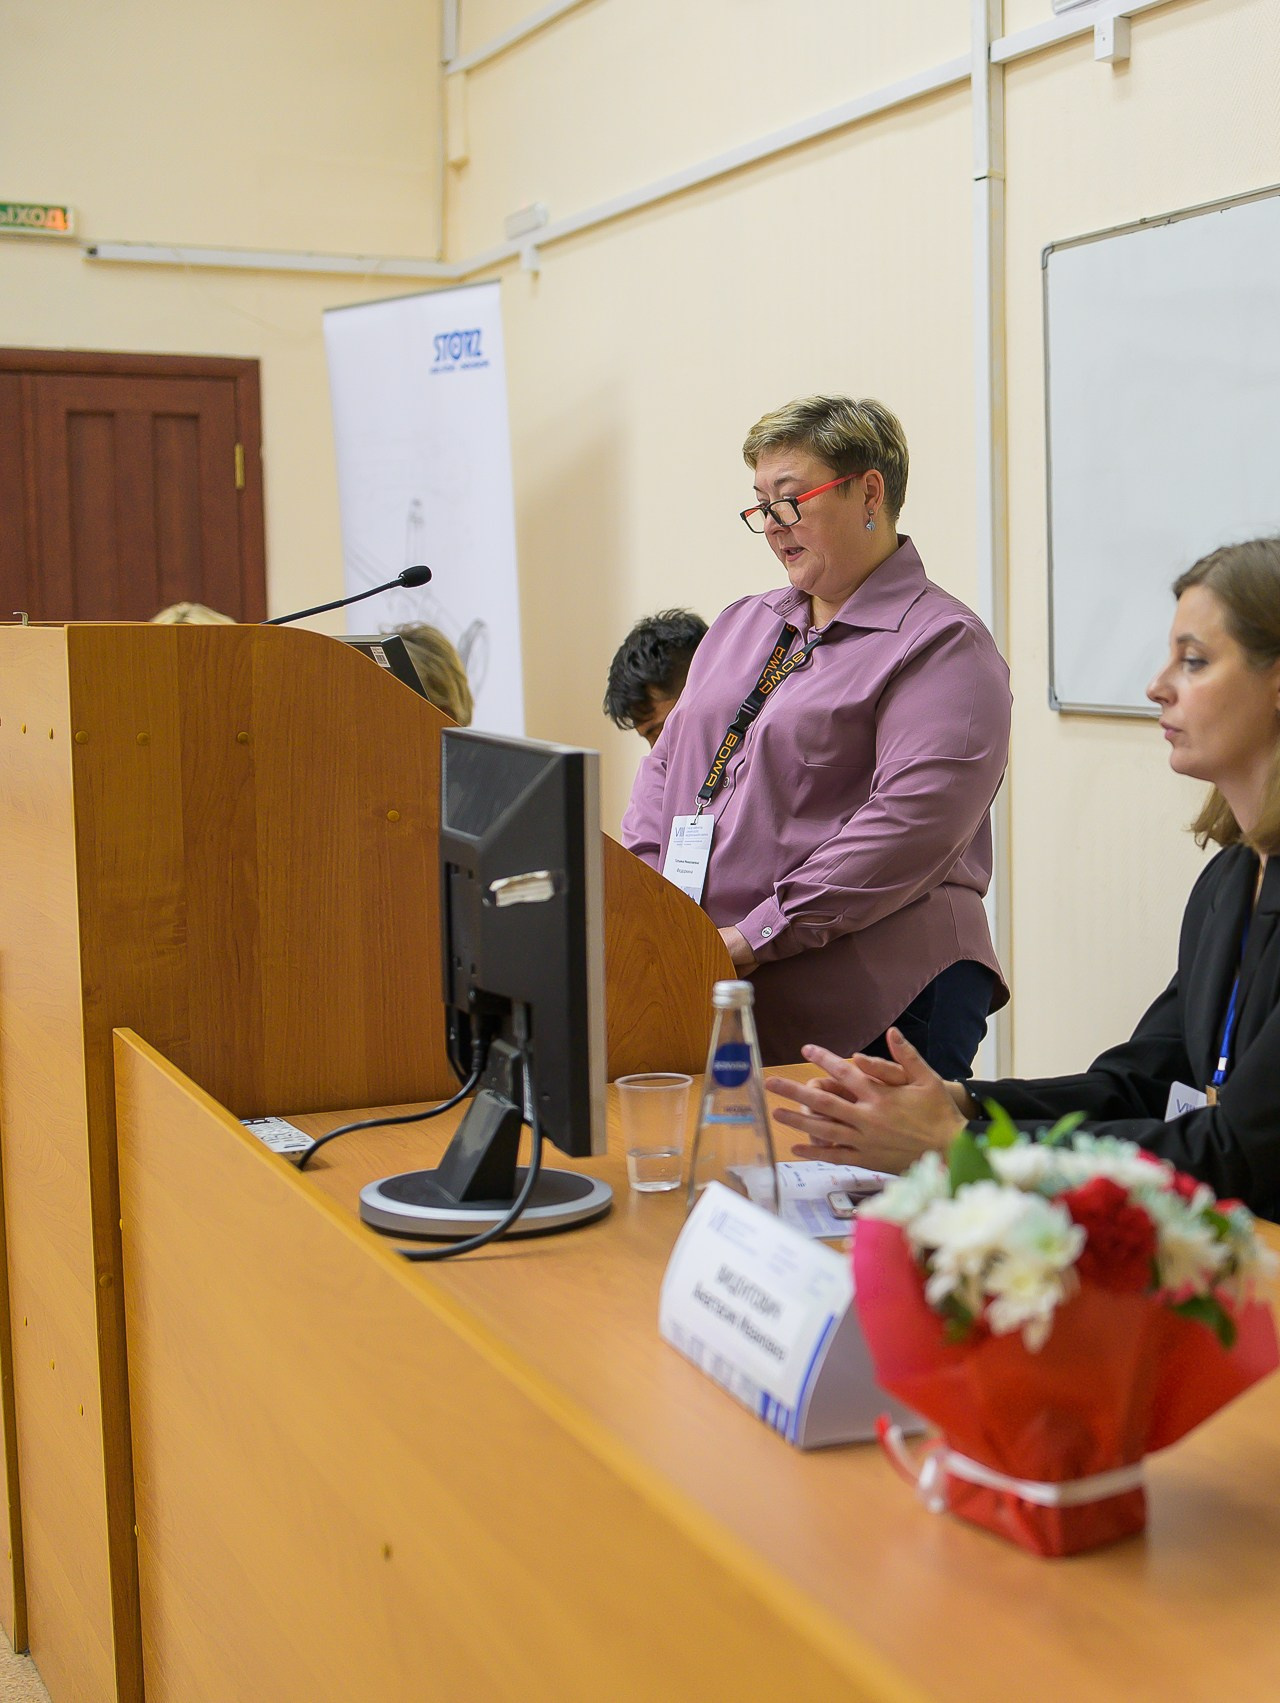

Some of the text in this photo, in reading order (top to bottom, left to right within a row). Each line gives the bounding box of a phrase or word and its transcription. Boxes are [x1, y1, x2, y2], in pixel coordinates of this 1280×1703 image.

[0, 206, 68, 231] ЫХОД
[758, 651, 807, 694] BOWA
[705, 732, 739, 787] BOWA
